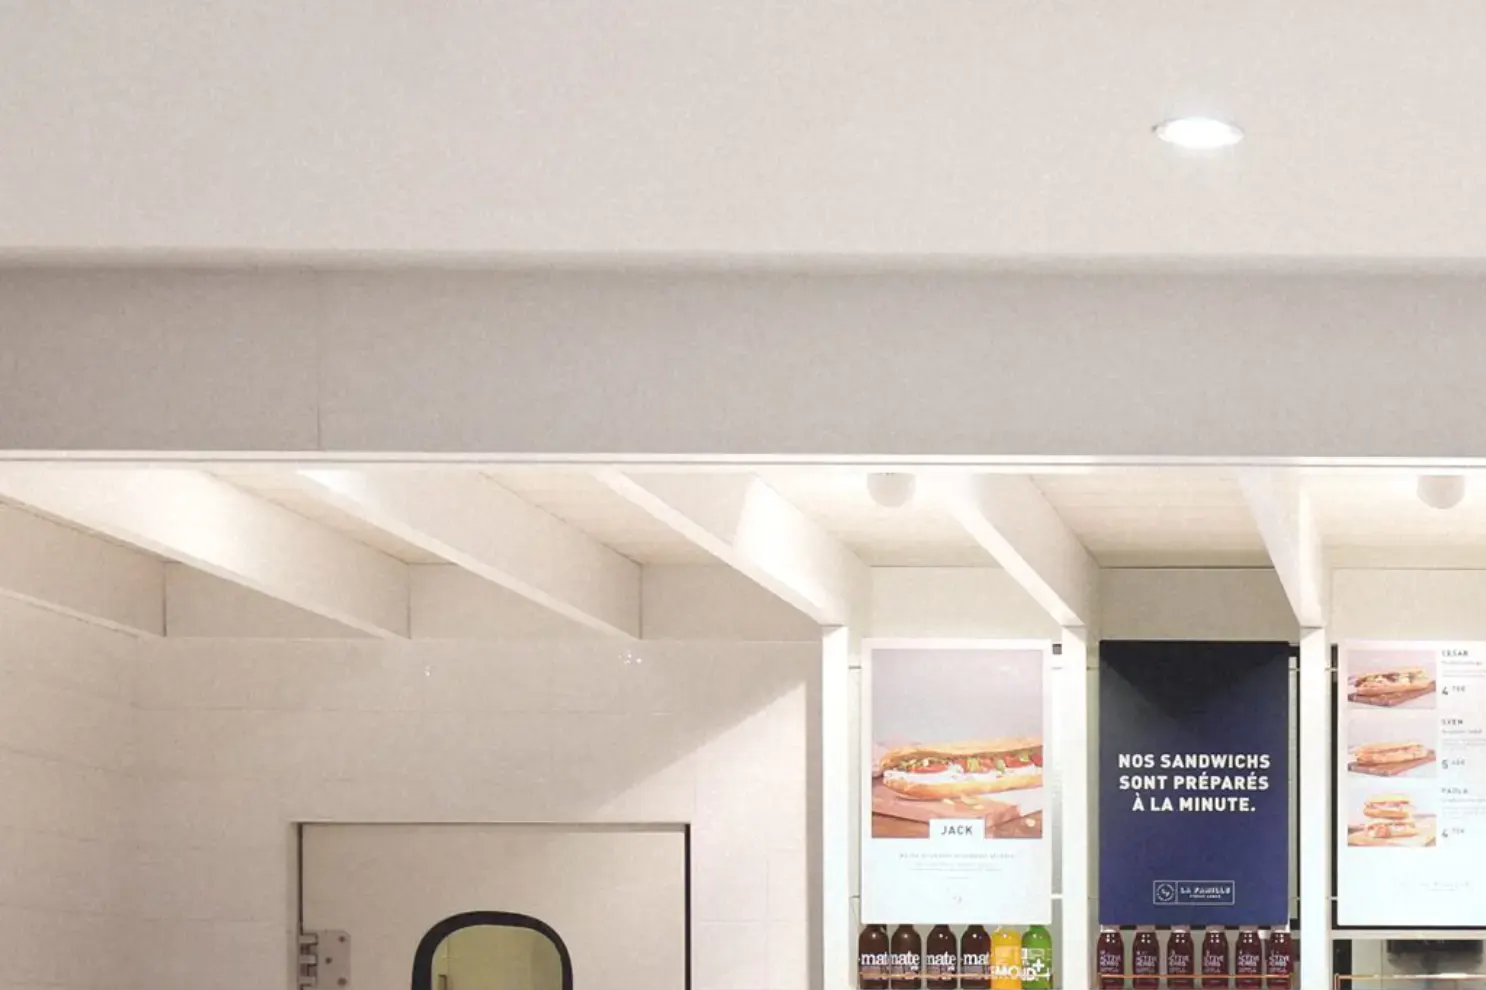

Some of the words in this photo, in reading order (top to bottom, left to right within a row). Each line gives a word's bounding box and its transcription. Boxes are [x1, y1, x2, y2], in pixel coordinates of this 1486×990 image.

[1118, 753, 1156, 769] NOS
[1160, 753, 1272, 769] SANDWICHS
[1119, 775, 1169, 790] SONT
[1173, 771, 1270, 790] PRÉPARÉS
[1132, 792, 1146, 812] À
[1150, 797, 1174, 812] LA
[1179, 797, 1257, 812] MINUTE.
[940, 825, 974, 836] JACK
